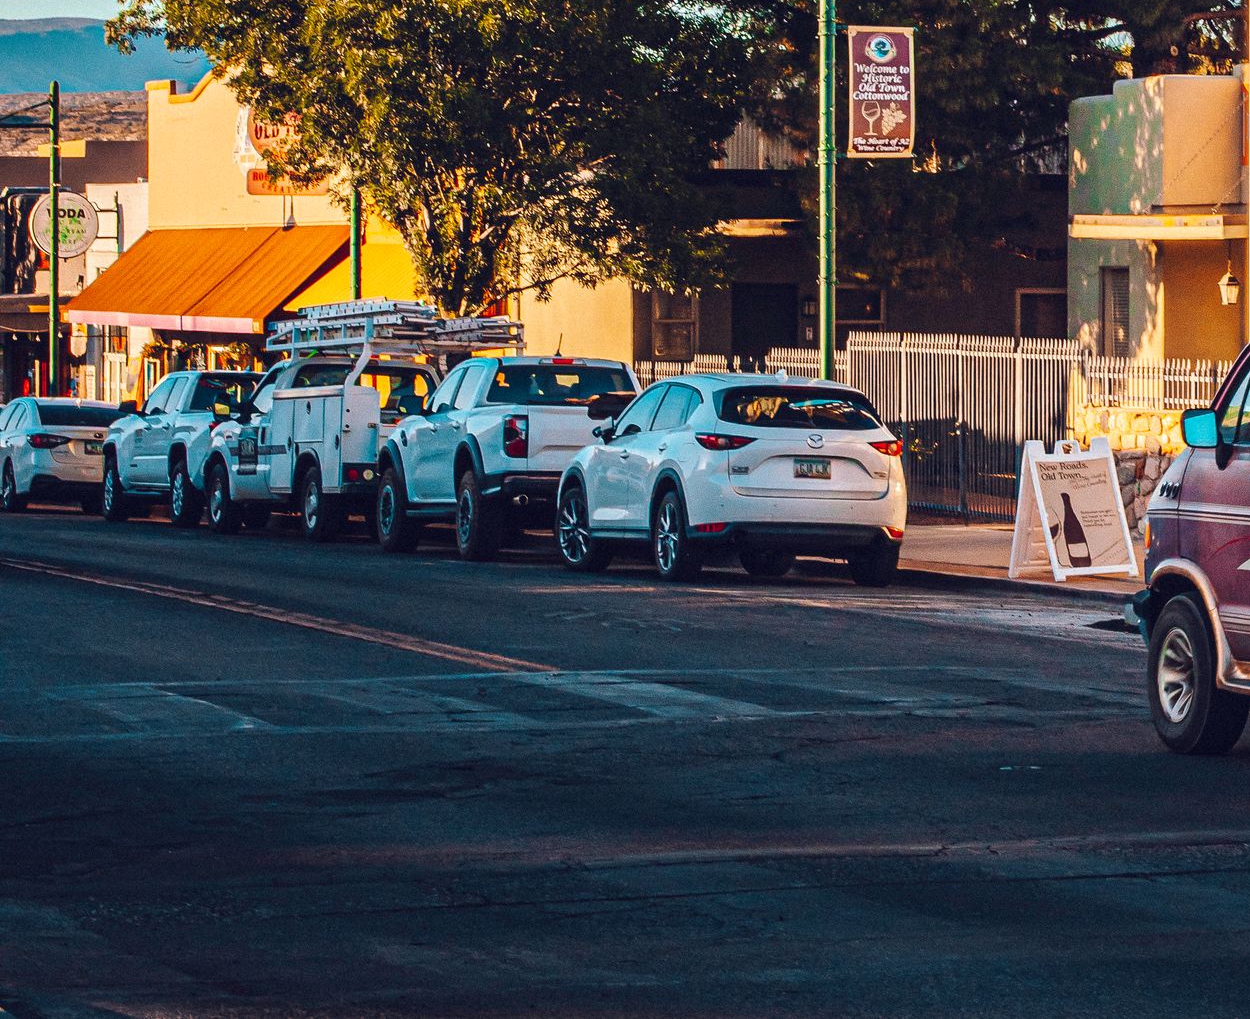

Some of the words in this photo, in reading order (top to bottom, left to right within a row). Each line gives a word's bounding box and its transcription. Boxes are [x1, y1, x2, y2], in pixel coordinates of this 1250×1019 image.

[854, 63, 897, 73] Welcome
[899, 65, 910, 74] to
[861, 74, 902, 83] Historic
[859, 83, 876, 92] Old
[878, 83, 905, 92] Town
[853, 91, 910, 101] Cottonwood
[853, 137, 867, 145] The
[890, 137, 899, 146] of
[1039, 462, 1058, 473] New
[1040, 472, 1057, 481] Old
